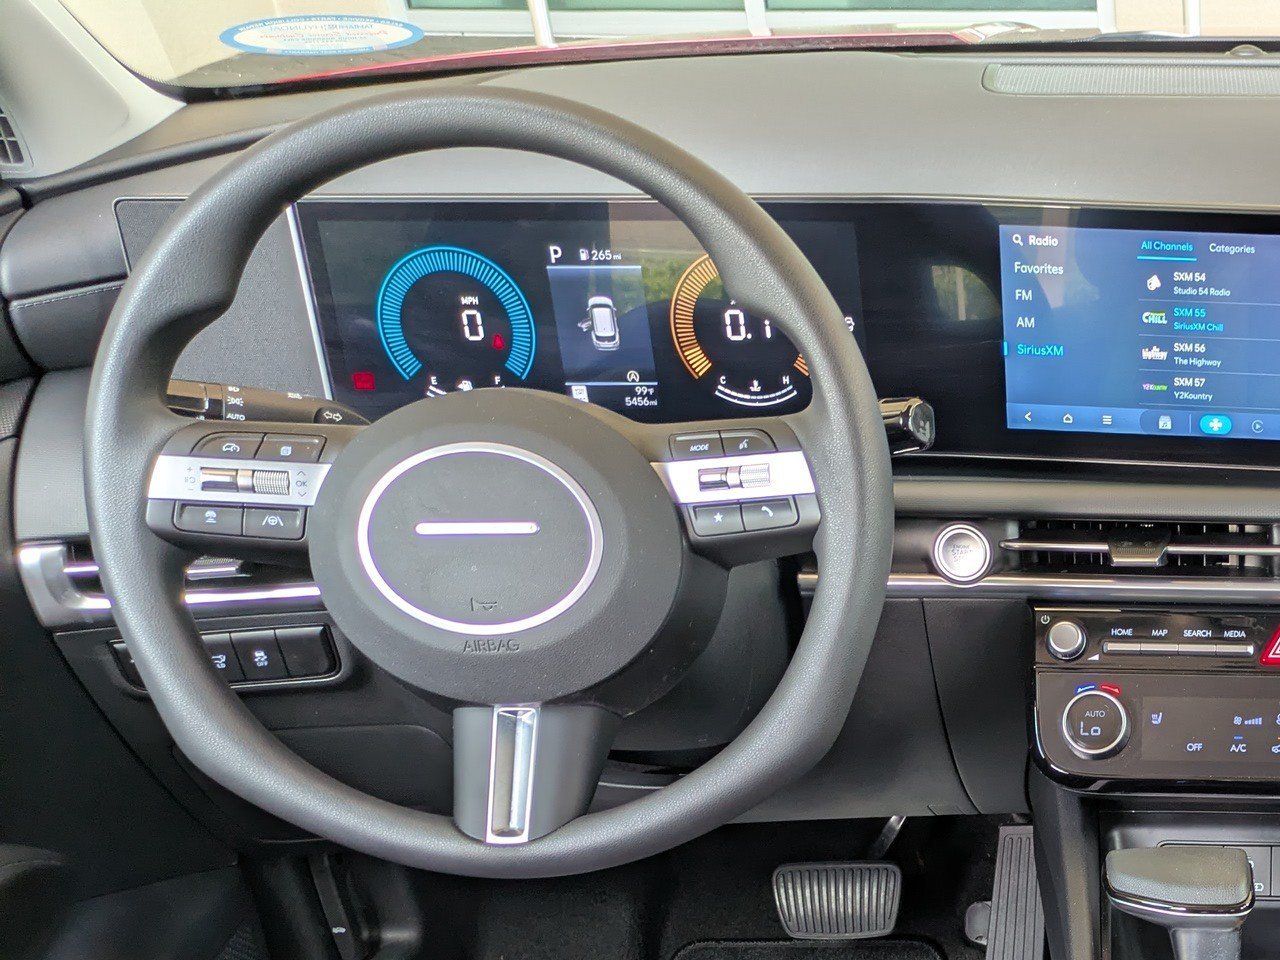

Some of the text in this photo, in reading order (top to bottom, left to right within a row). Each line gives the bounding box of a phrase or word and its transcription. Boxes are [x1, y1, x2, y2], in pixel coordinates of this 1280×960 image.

[1028, 235, 1059, 246] Radio
[1141, 241, 1193, 252] All Channels
[1209, 243, 1256, 255] Categories
[549, 245, 563, 264] P
[1014, 262, 1064, 275] Favorites
[1173, 272, 1206, 282] SXM 54
[1015, 289, 1032, 301] FM
[1173, 286, 1231, 297] Studio 54 Radio
[460, 296, 480, 305] MPH
[1173, 308, 1206, 318] SXM 55
[461, 309, 485, 341] 0
[1016, 317, 1035, 328] AM
[1173, 322, 1224, 332] SiriusXM Chill
[1017, 344, 1064, 356] SiriusXM
[1173, 343, 1206, 353] SXM 56
[1173, 357, 1222, 368] The Highway
[431, 376, 437, 385] E
[494, 376, 500, 385] F
[719, 376, 726, 384] C
[782, 376, 790, 384] H
[1173, 377, 1206, 388] SXM 57
[1173, 391, 1213, 402] Y2Kountry
[226, 413, 246, 421] AUTO
[690, 443, 709, 452] MODE
[295, 480, 308, 488] OK
[1111, 628, 1133, 636] HOME
[1151, 629, 1168, 637] MAP
[1183, 629, 1212, 638] SEARCH
[1223, 630, 1246, 638] MEDIA
[462, 638, 521, 654] AIRBAG
[1085, 710, 1106, 718] AUTO
[1186, 743, 1203, 752] OFF
[1229, 743, 1247, 753] A/C
